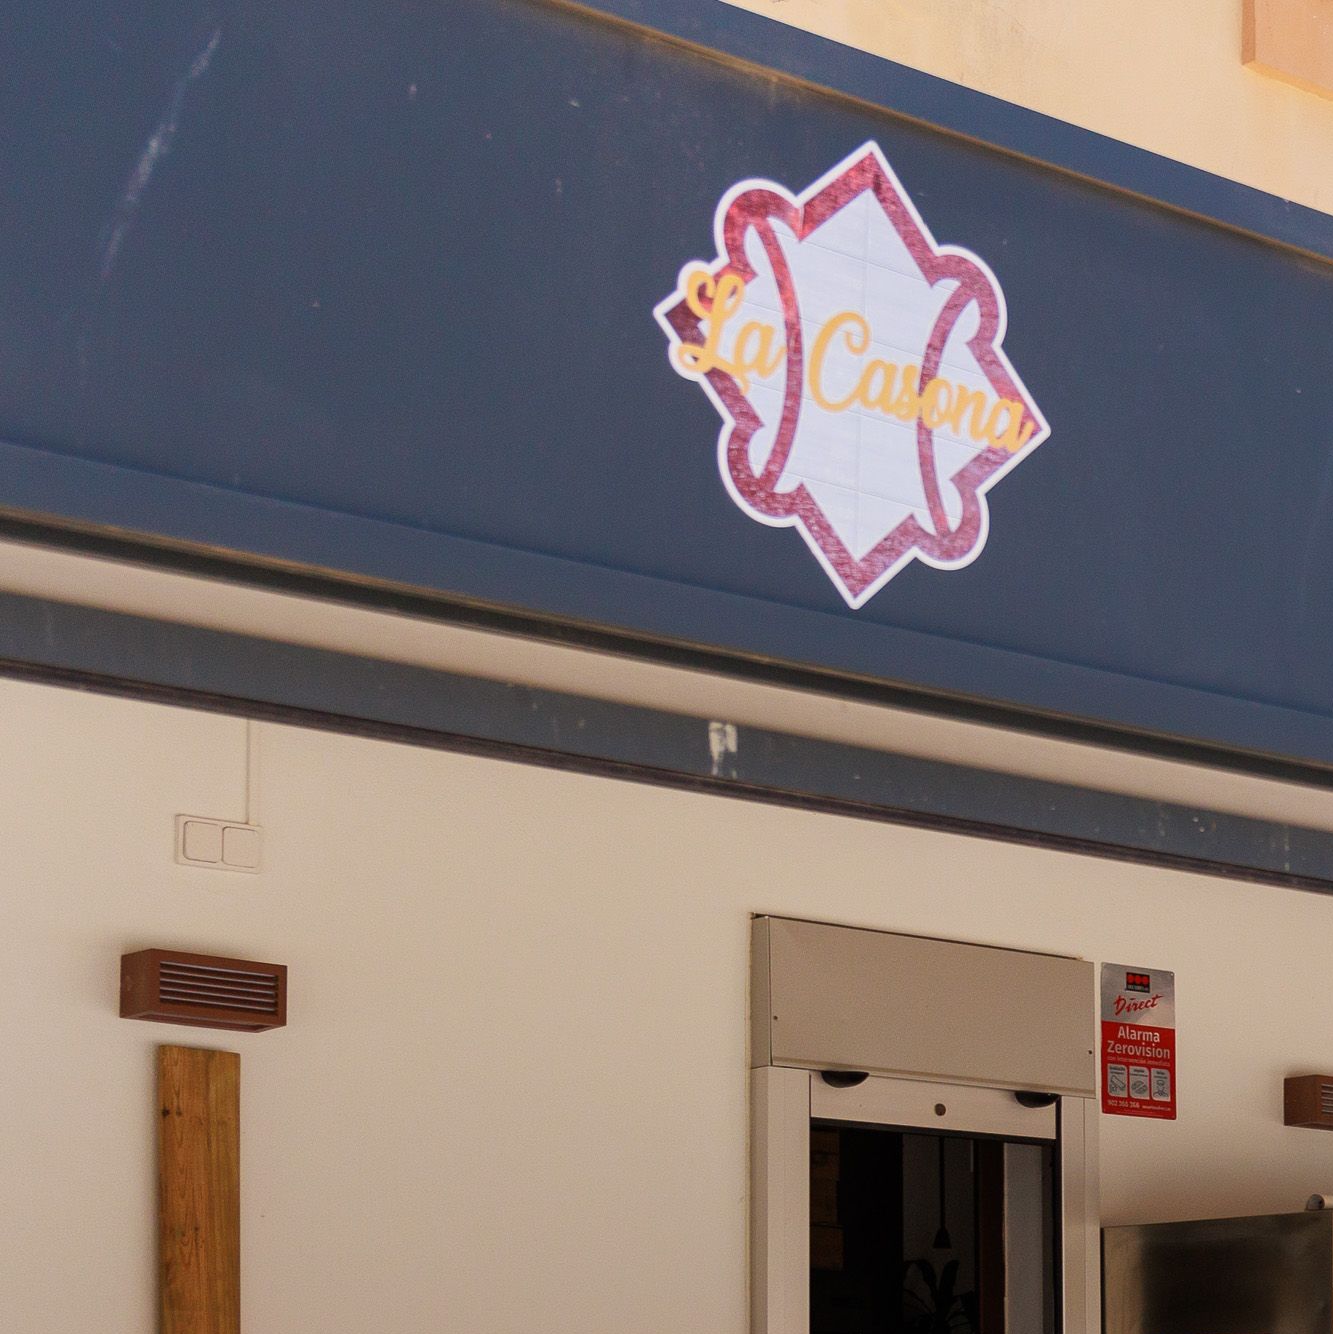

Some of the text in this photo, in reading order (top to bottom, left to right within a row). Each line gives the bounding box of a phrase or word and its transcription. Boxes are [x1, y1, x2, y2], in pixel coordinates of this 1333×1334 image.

[678, 270, 1035, 453] La Casona
[1113, 993, 1164, 1017] Direct
[1117, 1025, 1161, 1043] Alarma
[1106, 1040, 1171, 1060] Zerovision
